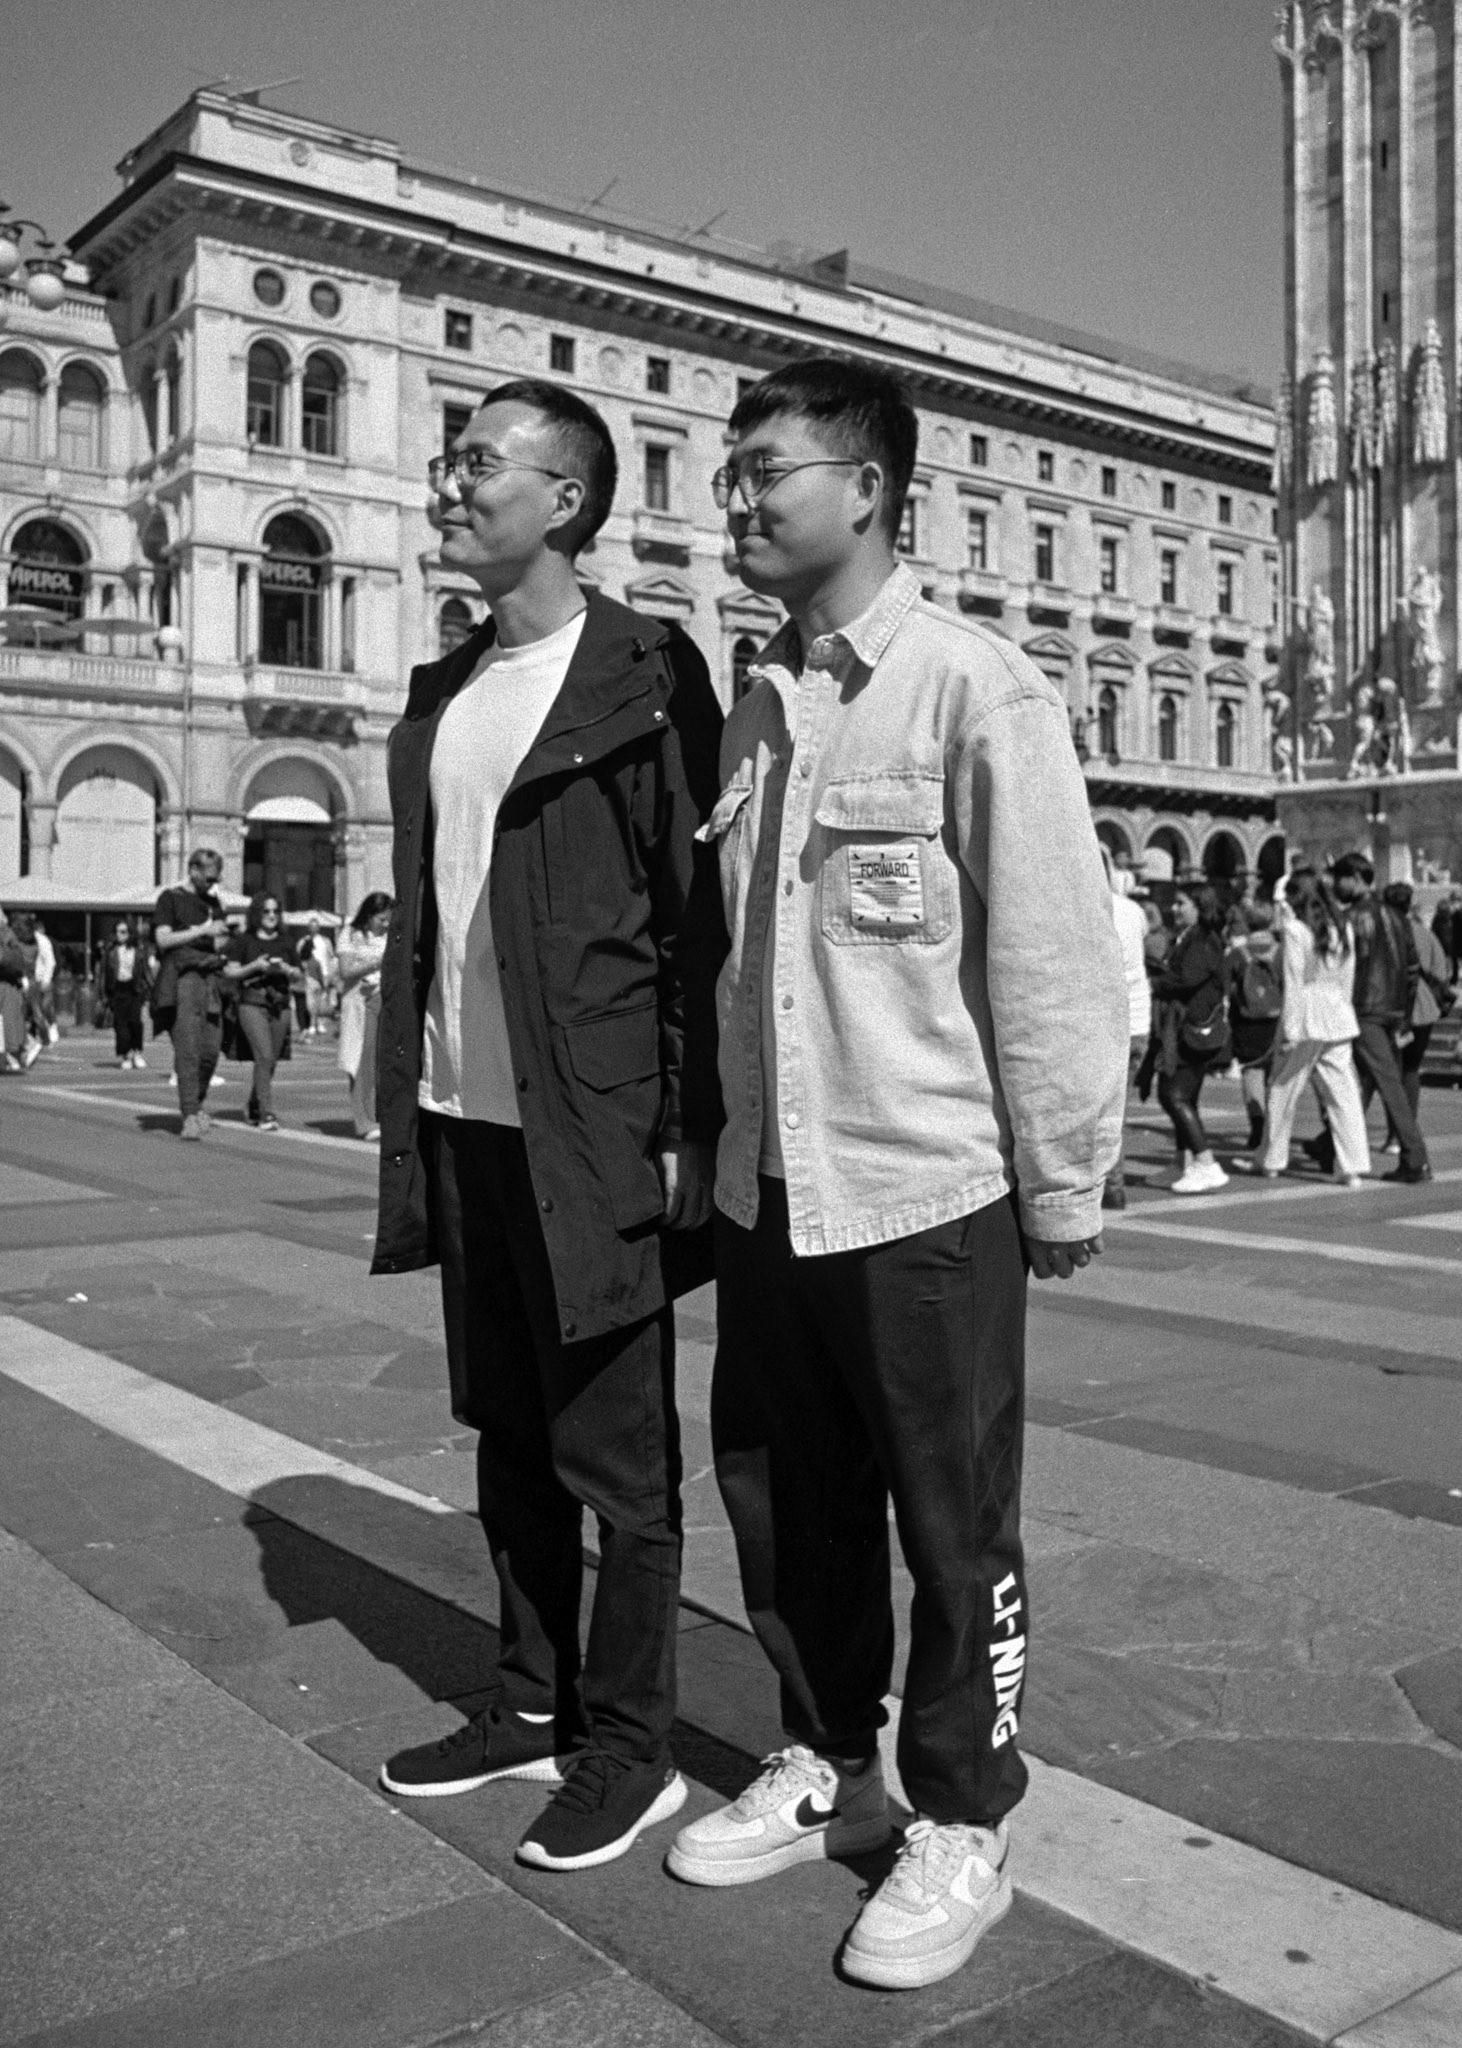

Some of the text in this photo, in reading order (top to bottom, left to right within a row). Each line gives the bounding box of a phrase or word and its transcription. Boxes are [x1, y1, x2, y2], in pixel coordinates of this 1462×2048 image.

[11, 566, 73, 592] APEROL
[860, 862, 909, 878] FORWARD
[989, 1571, 1026, 1749] LI-NING
